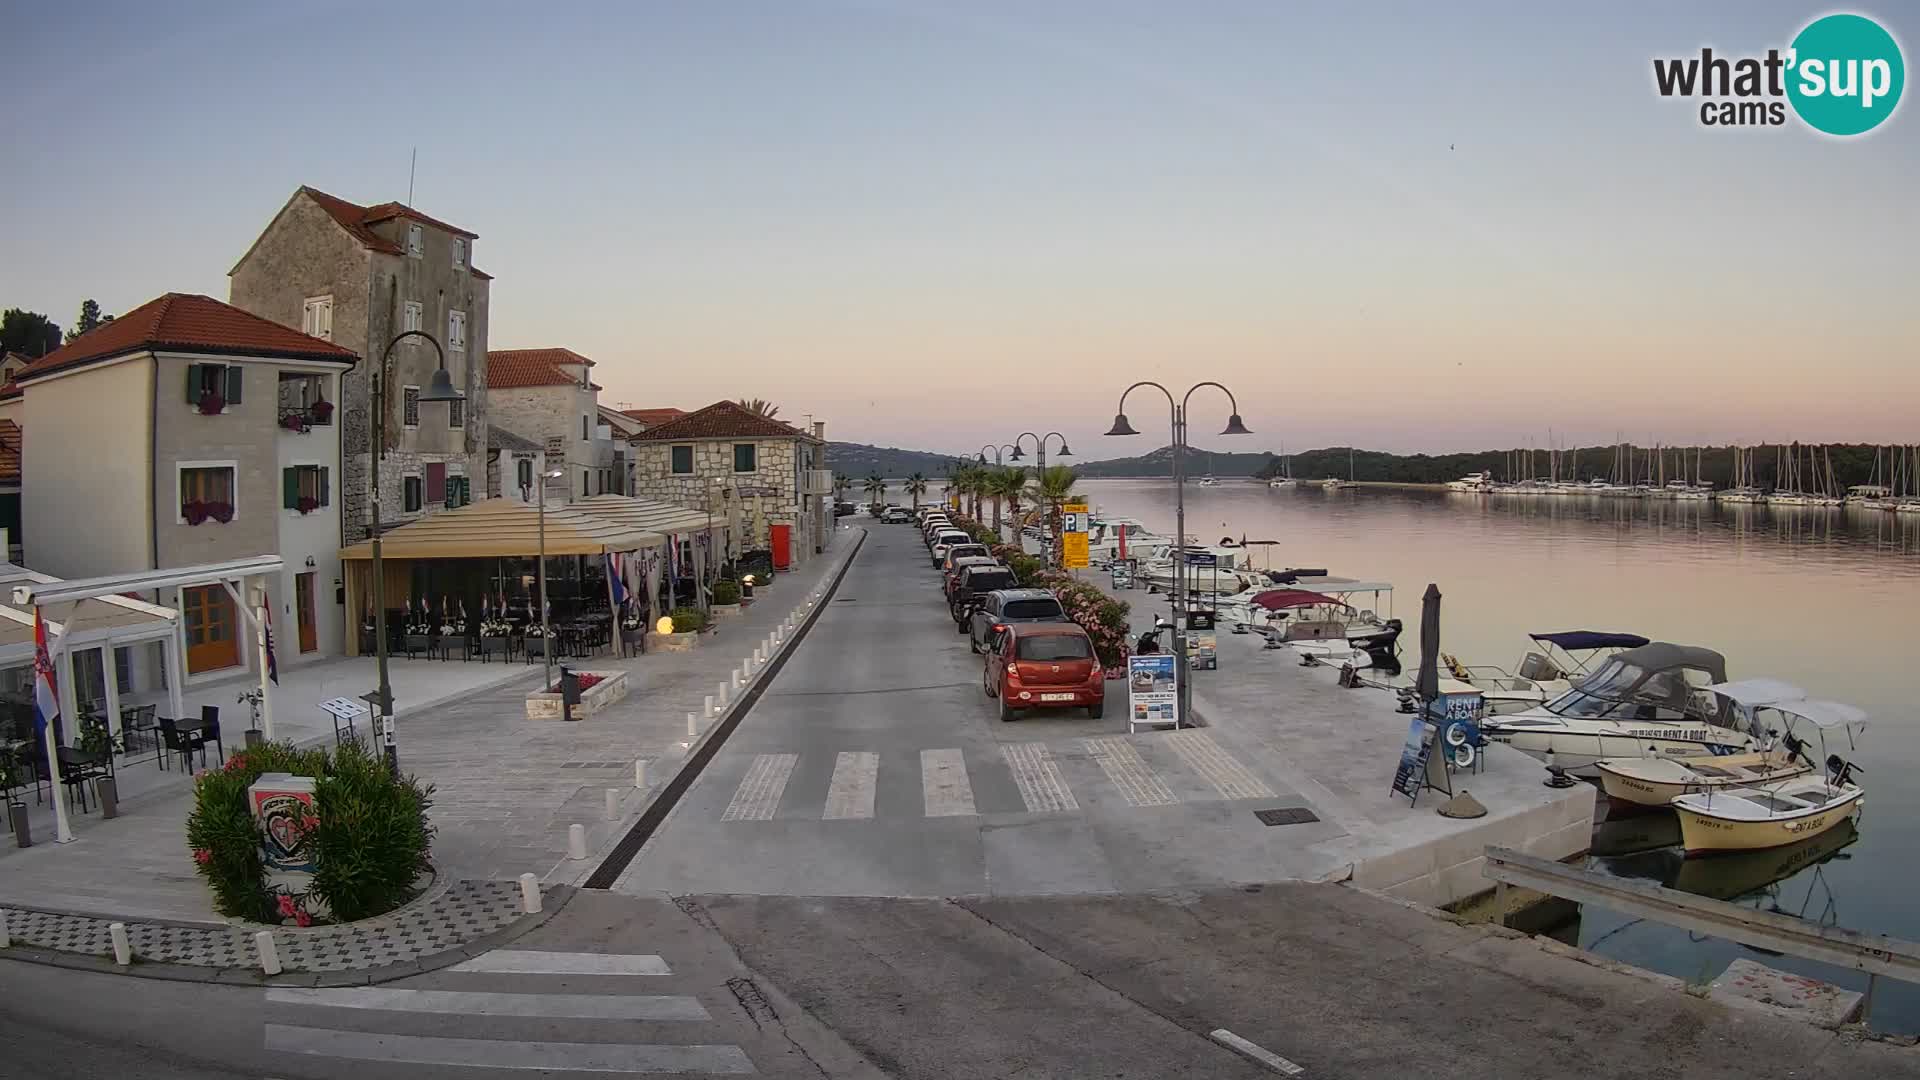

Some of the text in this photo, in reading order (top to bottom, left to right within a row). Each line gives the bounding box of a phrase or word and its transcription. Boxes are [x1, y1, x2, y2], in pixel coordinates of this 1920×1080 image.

[1447, 698, 1478, 711] RENT
[1446, 709, 1477, 720] A BOAT
[1663, 730, 1682, 740] RENT
[1683, 730, 1688, 740] A
[1689, 730, 1707, 741] BOAT
